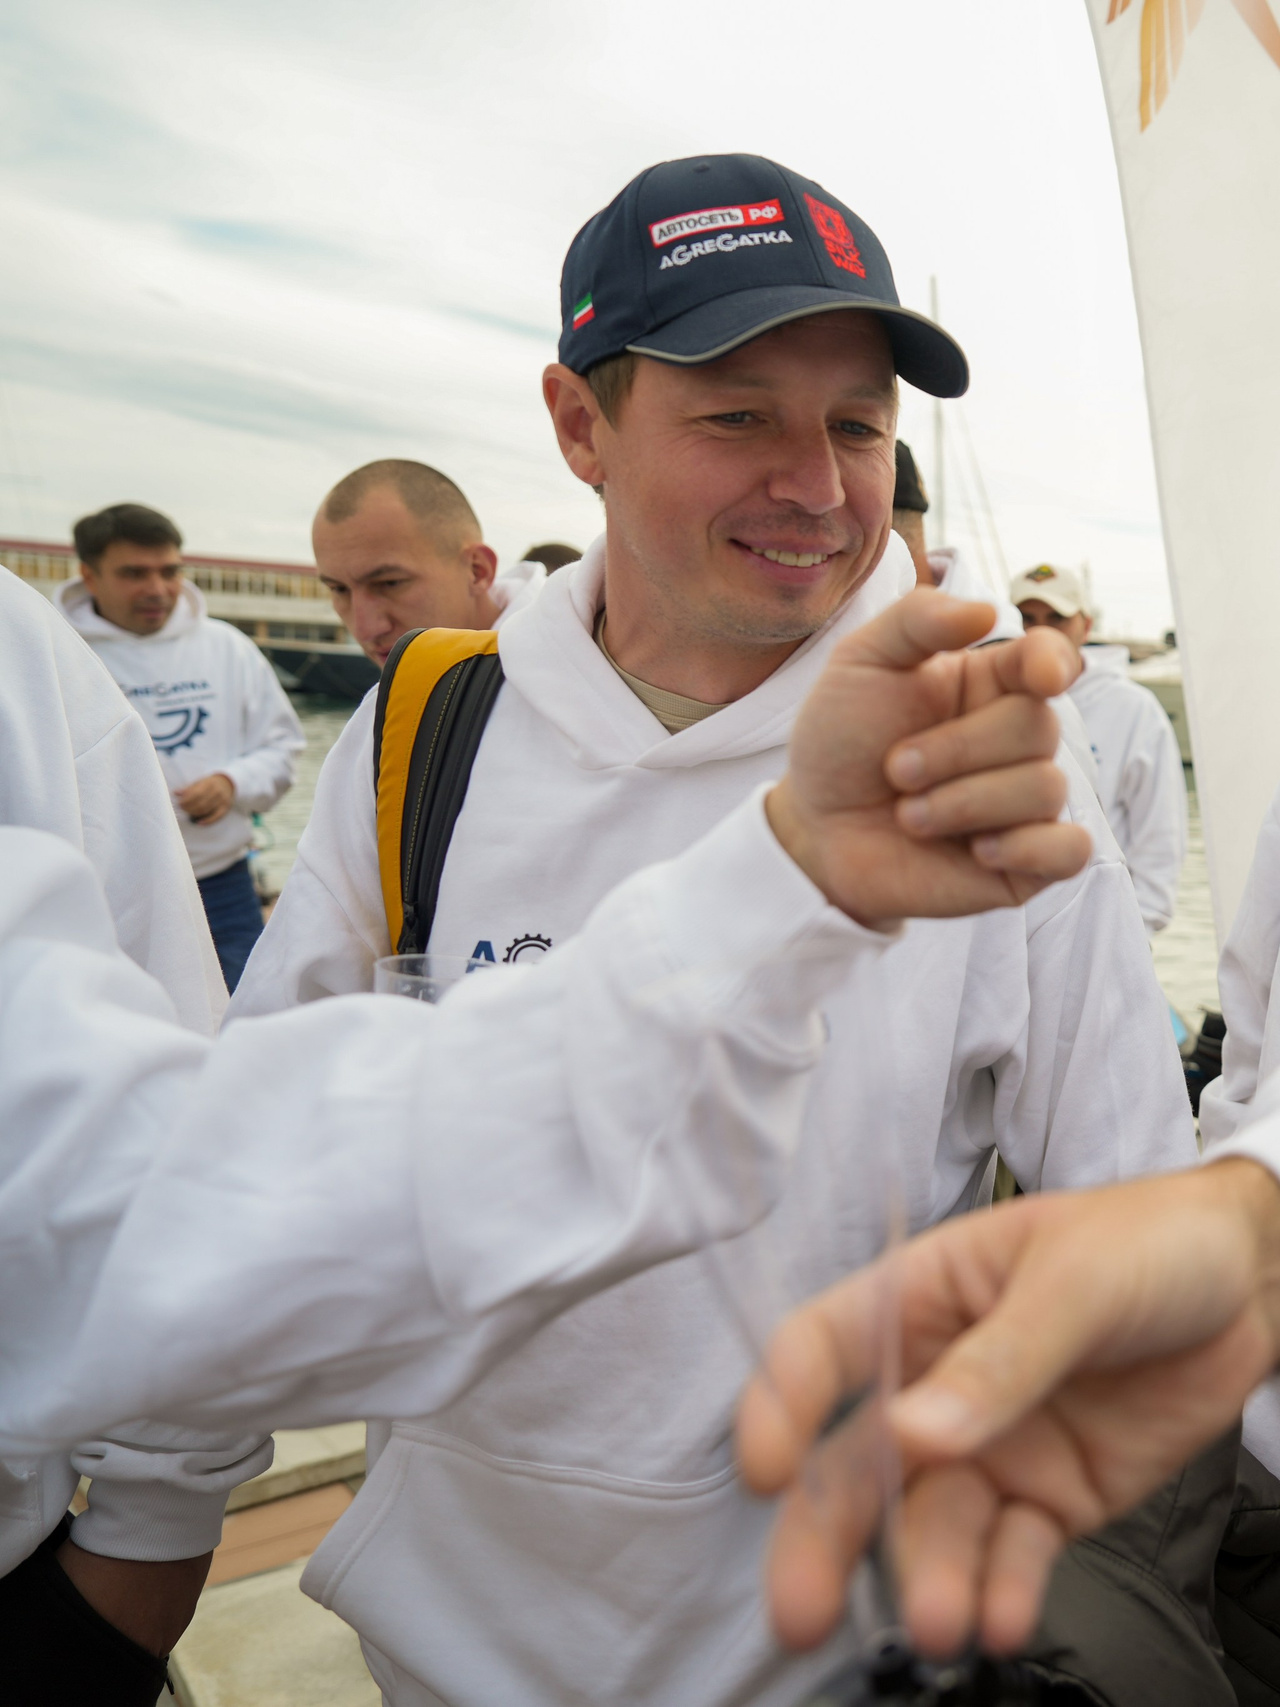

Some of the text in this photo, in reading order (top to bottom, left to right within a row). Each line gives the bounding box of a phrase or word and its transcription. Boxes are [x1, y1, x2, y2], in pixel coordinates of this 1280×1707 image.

[657, 205, 778, 240] АВТОСЕТЬ РФ
[659, 229, 793, 270] AGREGATKA
